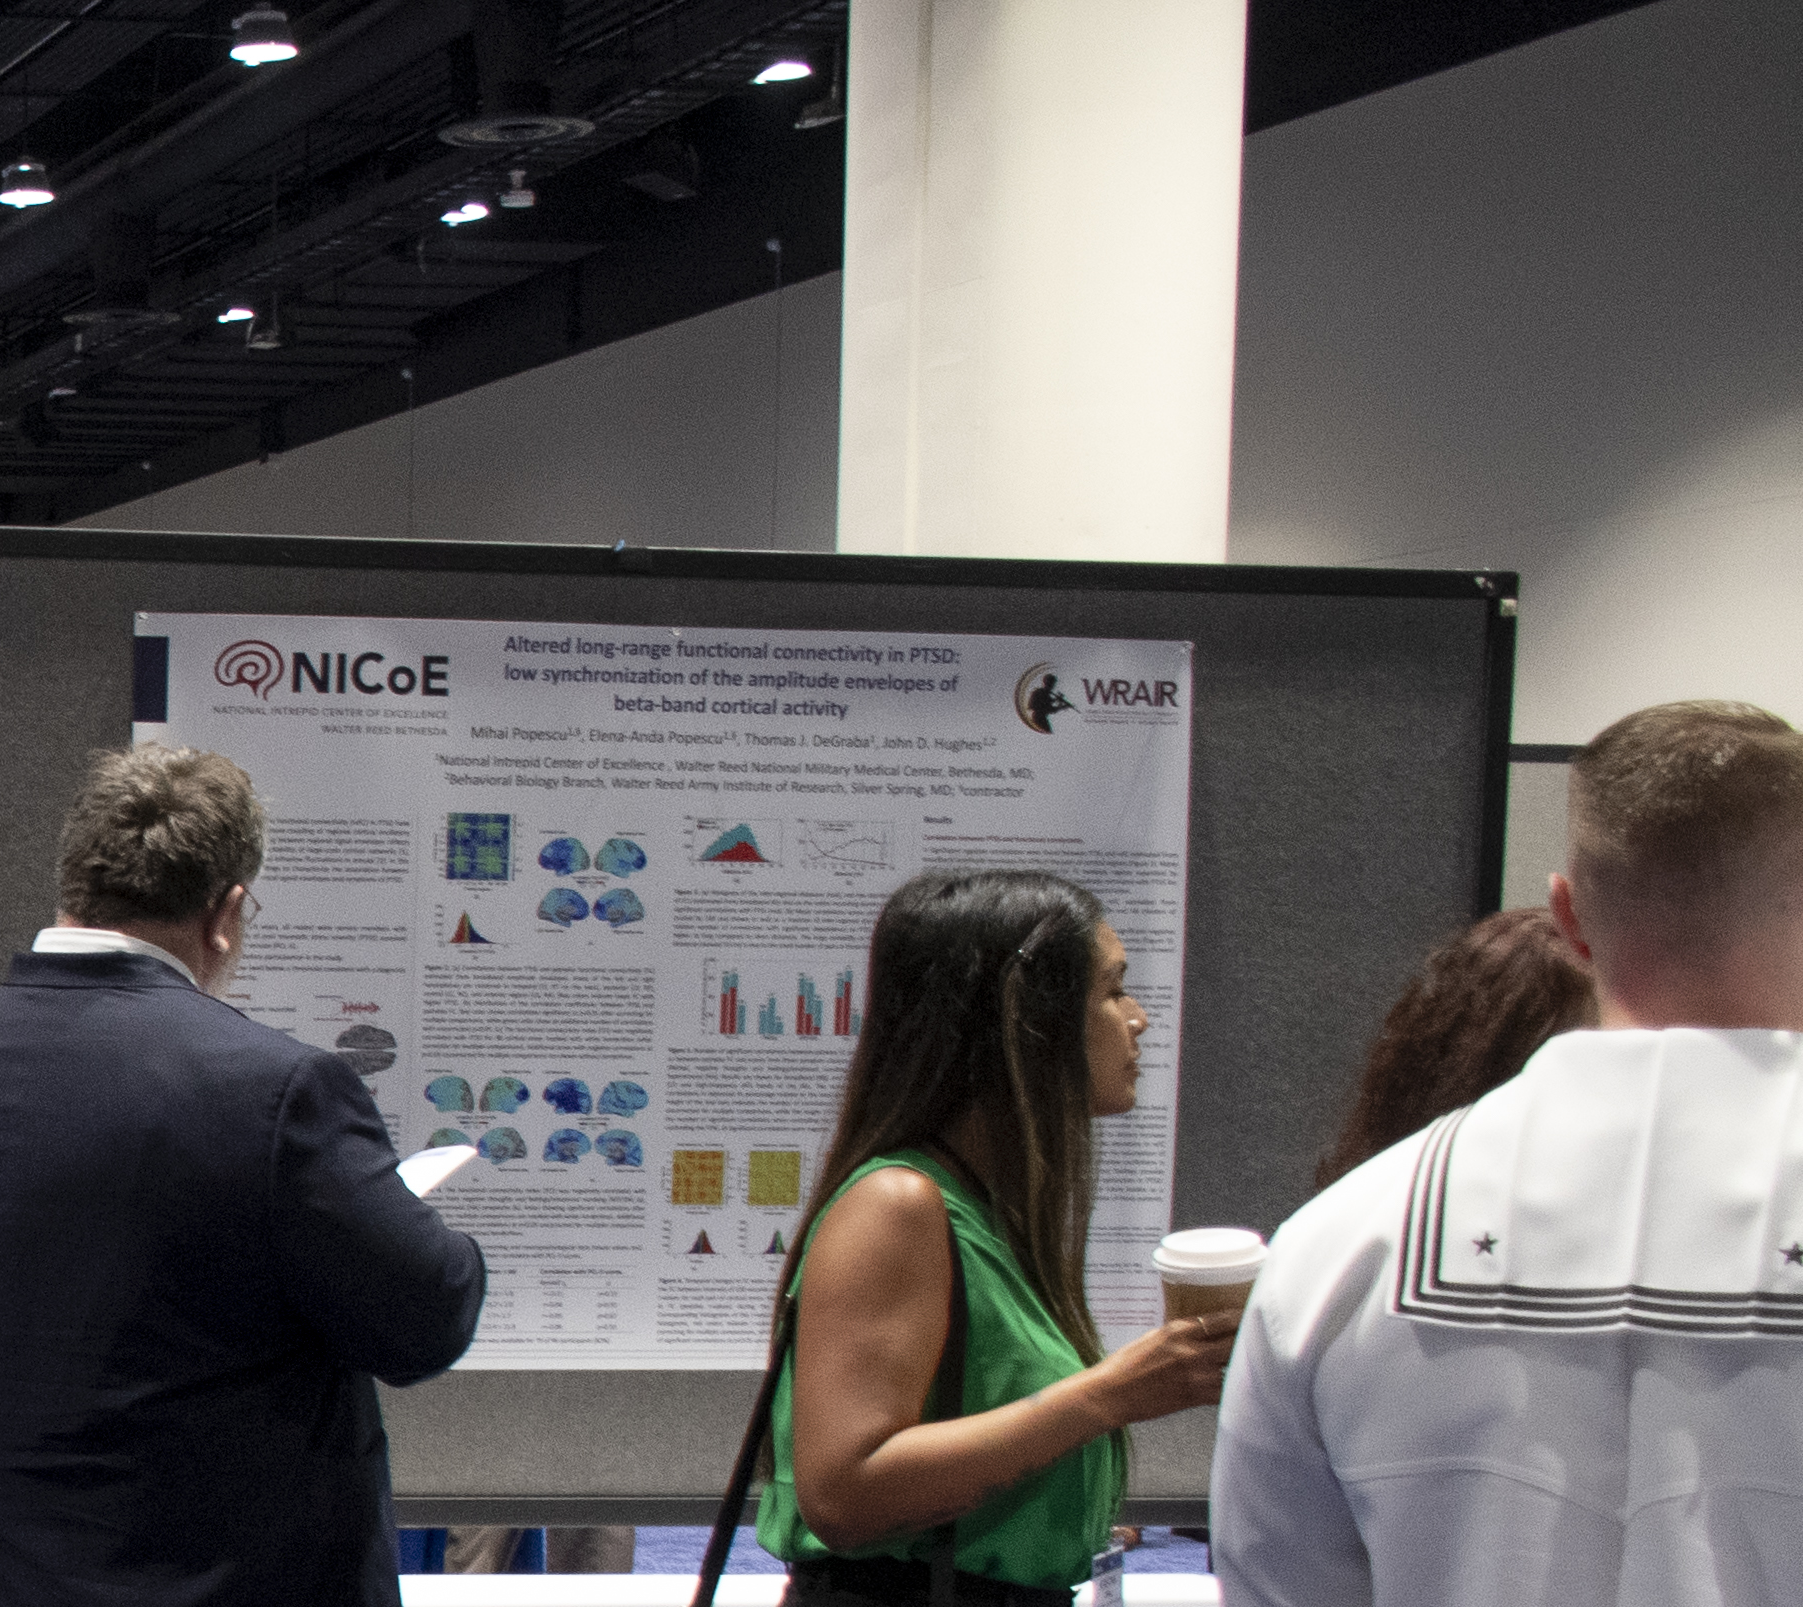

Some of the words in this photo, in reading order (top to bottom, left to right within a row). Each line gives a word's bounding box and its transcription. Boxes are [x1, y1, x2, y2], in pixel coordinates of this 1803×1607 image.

[505, 636, 571, 654] Altered
[577, 638, 670, 660] long-range
[677, 641, 768, 660] functional
[774, 643, 883, 665] connectivity
[888, 645, 904, 662] in
[910, 647, 960, 664] PTSD:
[291, 651, 449, 696] NICoE
[504, 663, 537, 681] low
[541, 666, 684, 686] synchronization
[690, 668, 709, 685] of
[713, 670, 742, 687] the
[748, 671, 839, 692] amplitude
[844, 674, 935, 694] envelopes
[940, 674, 959, 692] of
[1082, 678, 1179, 707] WRAIR
[213, 706, 266, 716] NATIONAL
[271, 707, 318, 717] INTREPID
[322, 708, 362, 717] CENTER
[614, 694, 706, 713] beta-band
[711, 697, 776, 715] cortical
[782, 699, 847, 720] activity
[589, 729, 664, 743] Elena-Anda
[745, 732, 796, 746] Thomas
[883, 736, 913, 749] John
[494, 756, 540, 769] Intrepid
[544, 757, 583, 769] Center
[587, 757, 599, 769] of
[603, 758, 665, 771] Excellence
[675, 760, 715, 772] Walter
[718, 761, 748, 773] Reed
[751, 761, 802, 774] National
[805, 762, 850, 776] Military
[854, 764, 900, 776] Medical
[515, 775, 559, 789] Biology
[611, 777, 651, 789] Walter
[655, 778, 684, 790] Reed
[688, 779, 719, 792] Army
[723, 780, 772, 792] Institute
[775, 780, 788, 792] of
[851, 783, 882, 794] Silver
